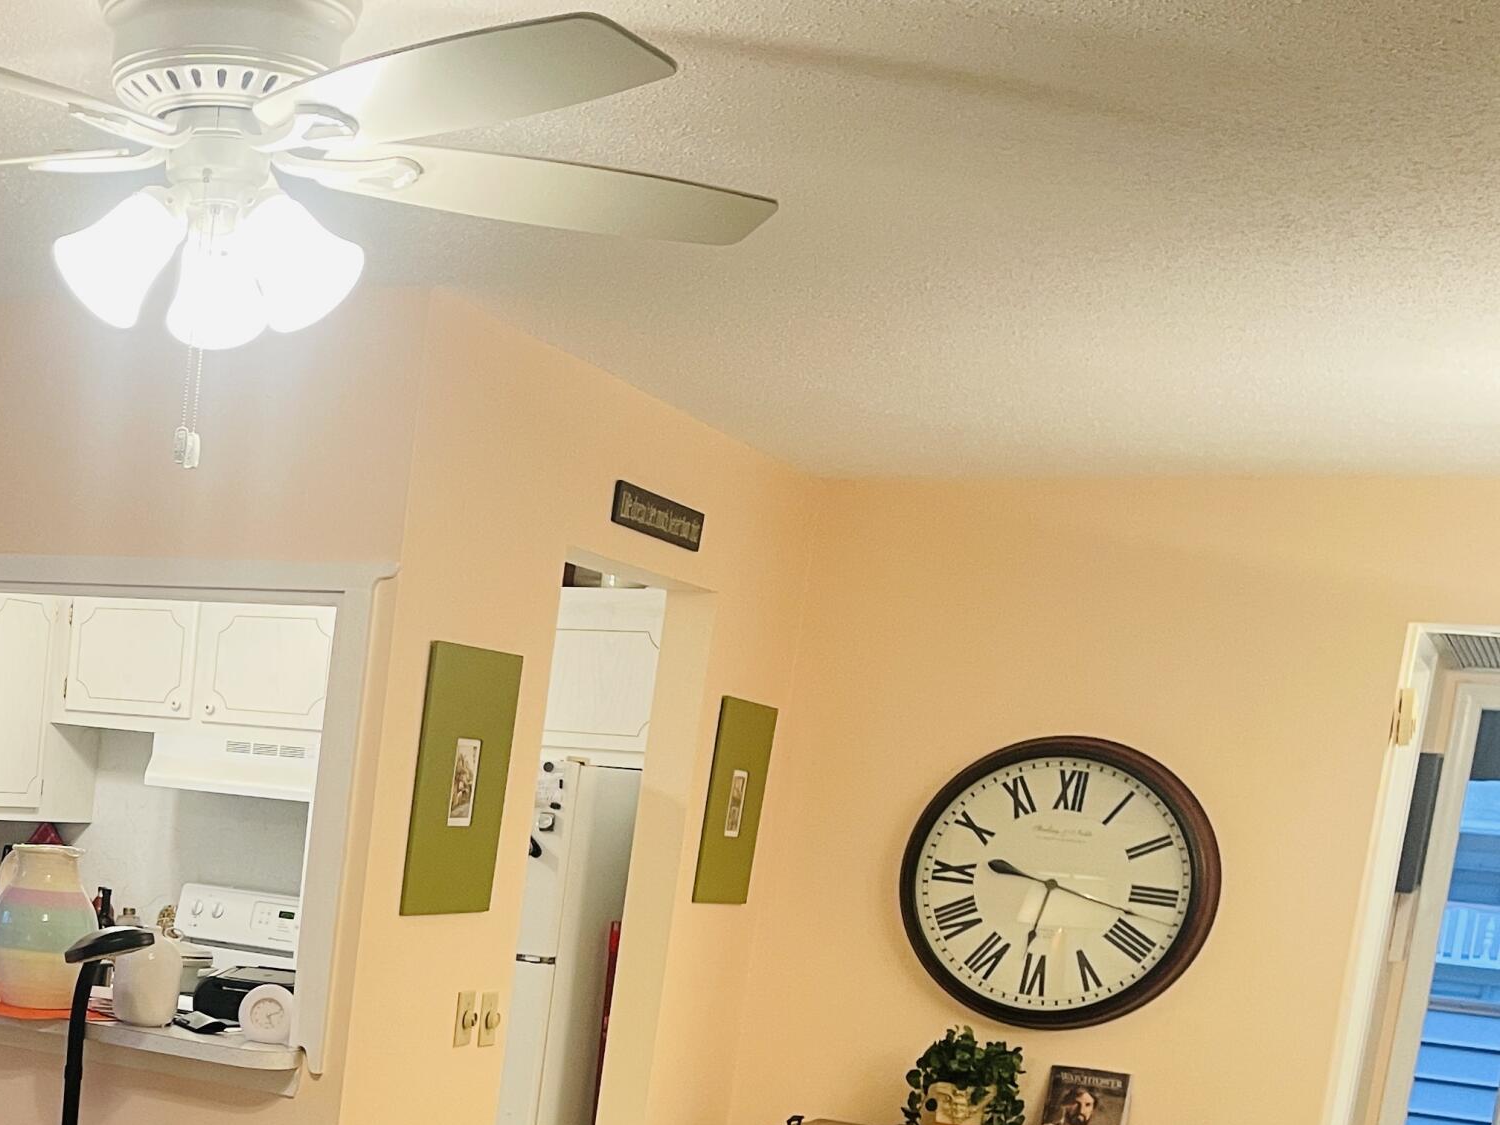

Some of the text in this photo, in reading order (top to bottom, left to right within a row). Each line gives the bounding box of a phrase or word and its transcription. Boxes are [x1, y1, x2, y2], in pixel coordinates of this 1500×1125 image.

[1002, 775, 1037, 819] XI
[1052, 769, 1089, 812] XII
[1102, 791, 1135, 825] I
[954, 811, 996, 846] X
[1125, 834, 1174, 860] II
[931, 859, 977, 884] IX
[1128, 884, 1179, 908] III
[934, 895, 983, 941] VIII
[964, 931, 1011, 980] VII
[1103, 917, 1157, 964] IIII
[1019, 952, 1046, 997] VI
[1076, 949, 1103, 992] V
